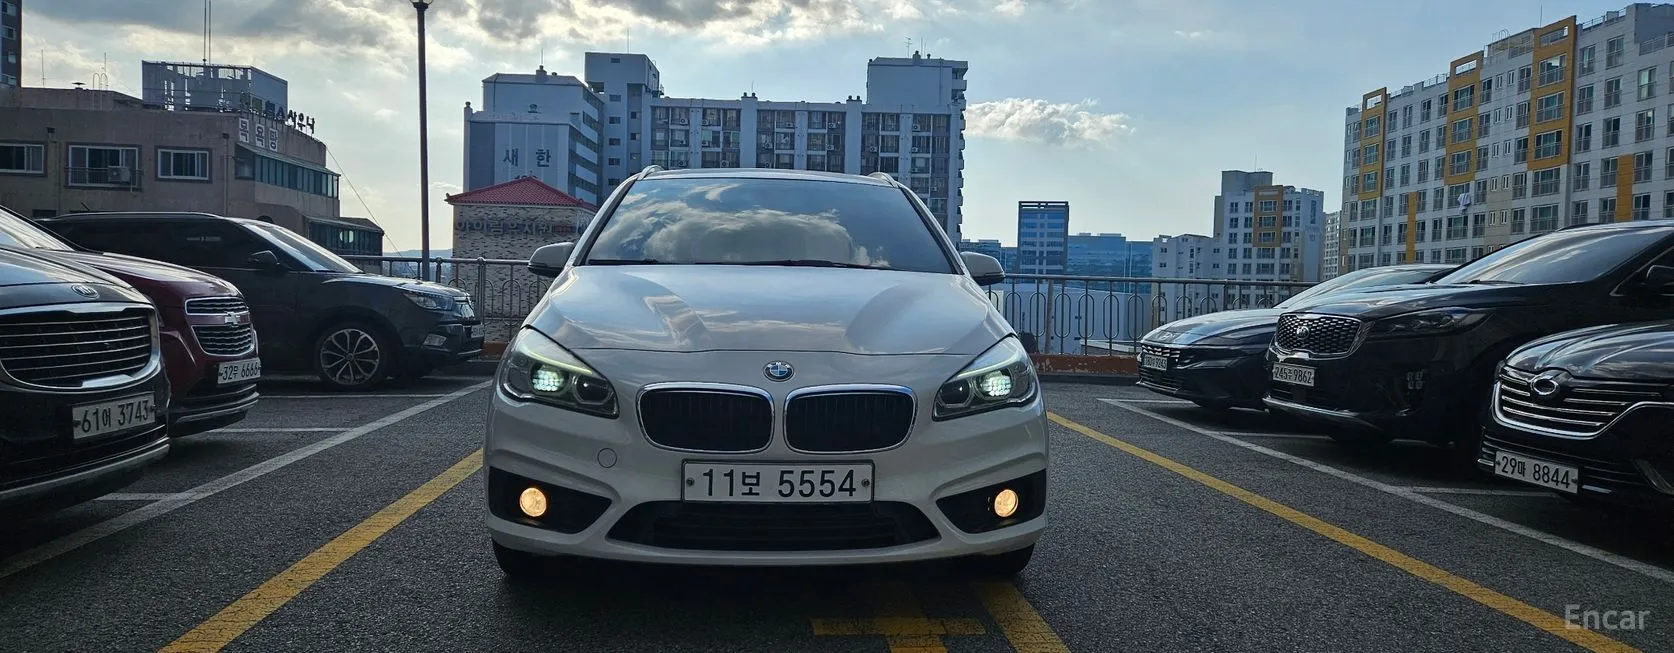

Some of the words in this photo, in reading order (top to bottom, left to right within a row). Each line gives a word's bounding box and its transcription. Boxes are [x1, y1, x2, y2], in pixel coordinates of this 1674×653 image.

[241, 361, 258, 378] 6666
[1293, 368, 1312, 384] 9862
[81, 408, 111, 433] 61어
[118, 399, 149, 426] 3743
[702, 468, 761, 497] 11보
[778, 469, 857, 498] 5554
[1501, 455, 1527, 477] 29마
[1532, 463, 1570, 489] 8844
